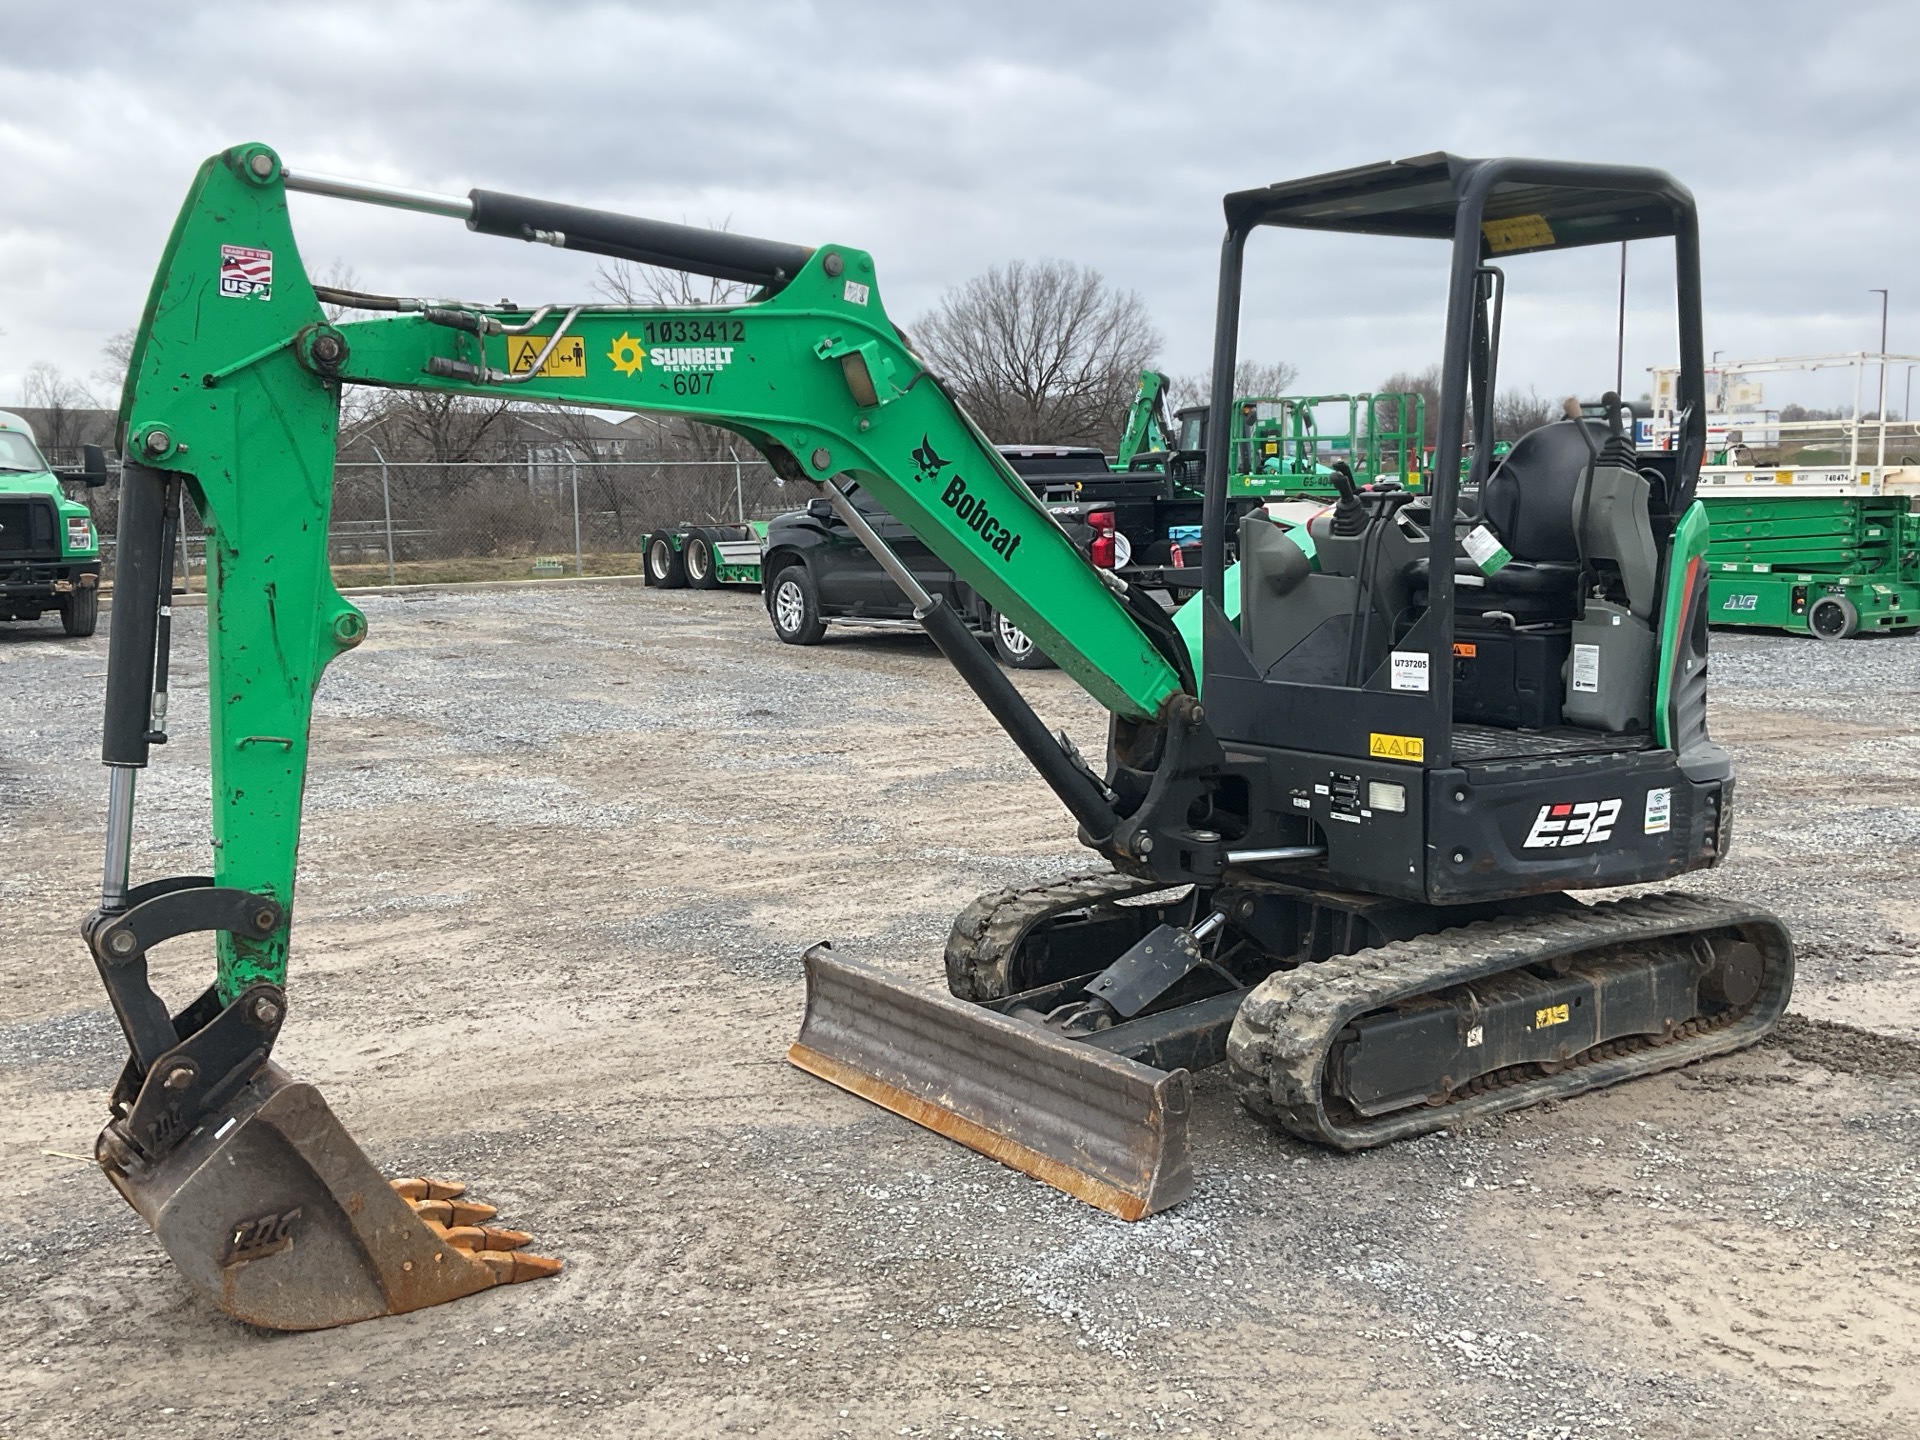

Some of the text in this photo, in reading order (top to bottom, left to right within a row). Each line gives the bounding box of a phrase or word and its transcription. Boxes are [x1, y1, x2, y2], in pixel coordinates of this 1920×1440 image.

[224, 247, 245, 255] MADE
[257, 251, 268, 259] THE
[223, 279, 265, 294] USA
[645, 321, 745, 342] 1033412
[650, 347, 734, 365] SUNBELT
[673, 372, 714, 396] 607
[940, 473, 1022, 563] Bobcat
[1722, 594, 1759, 611] JLG
[1394, 658, 1428, 669] U737205
[1522, 798, 1623, 848] E32
